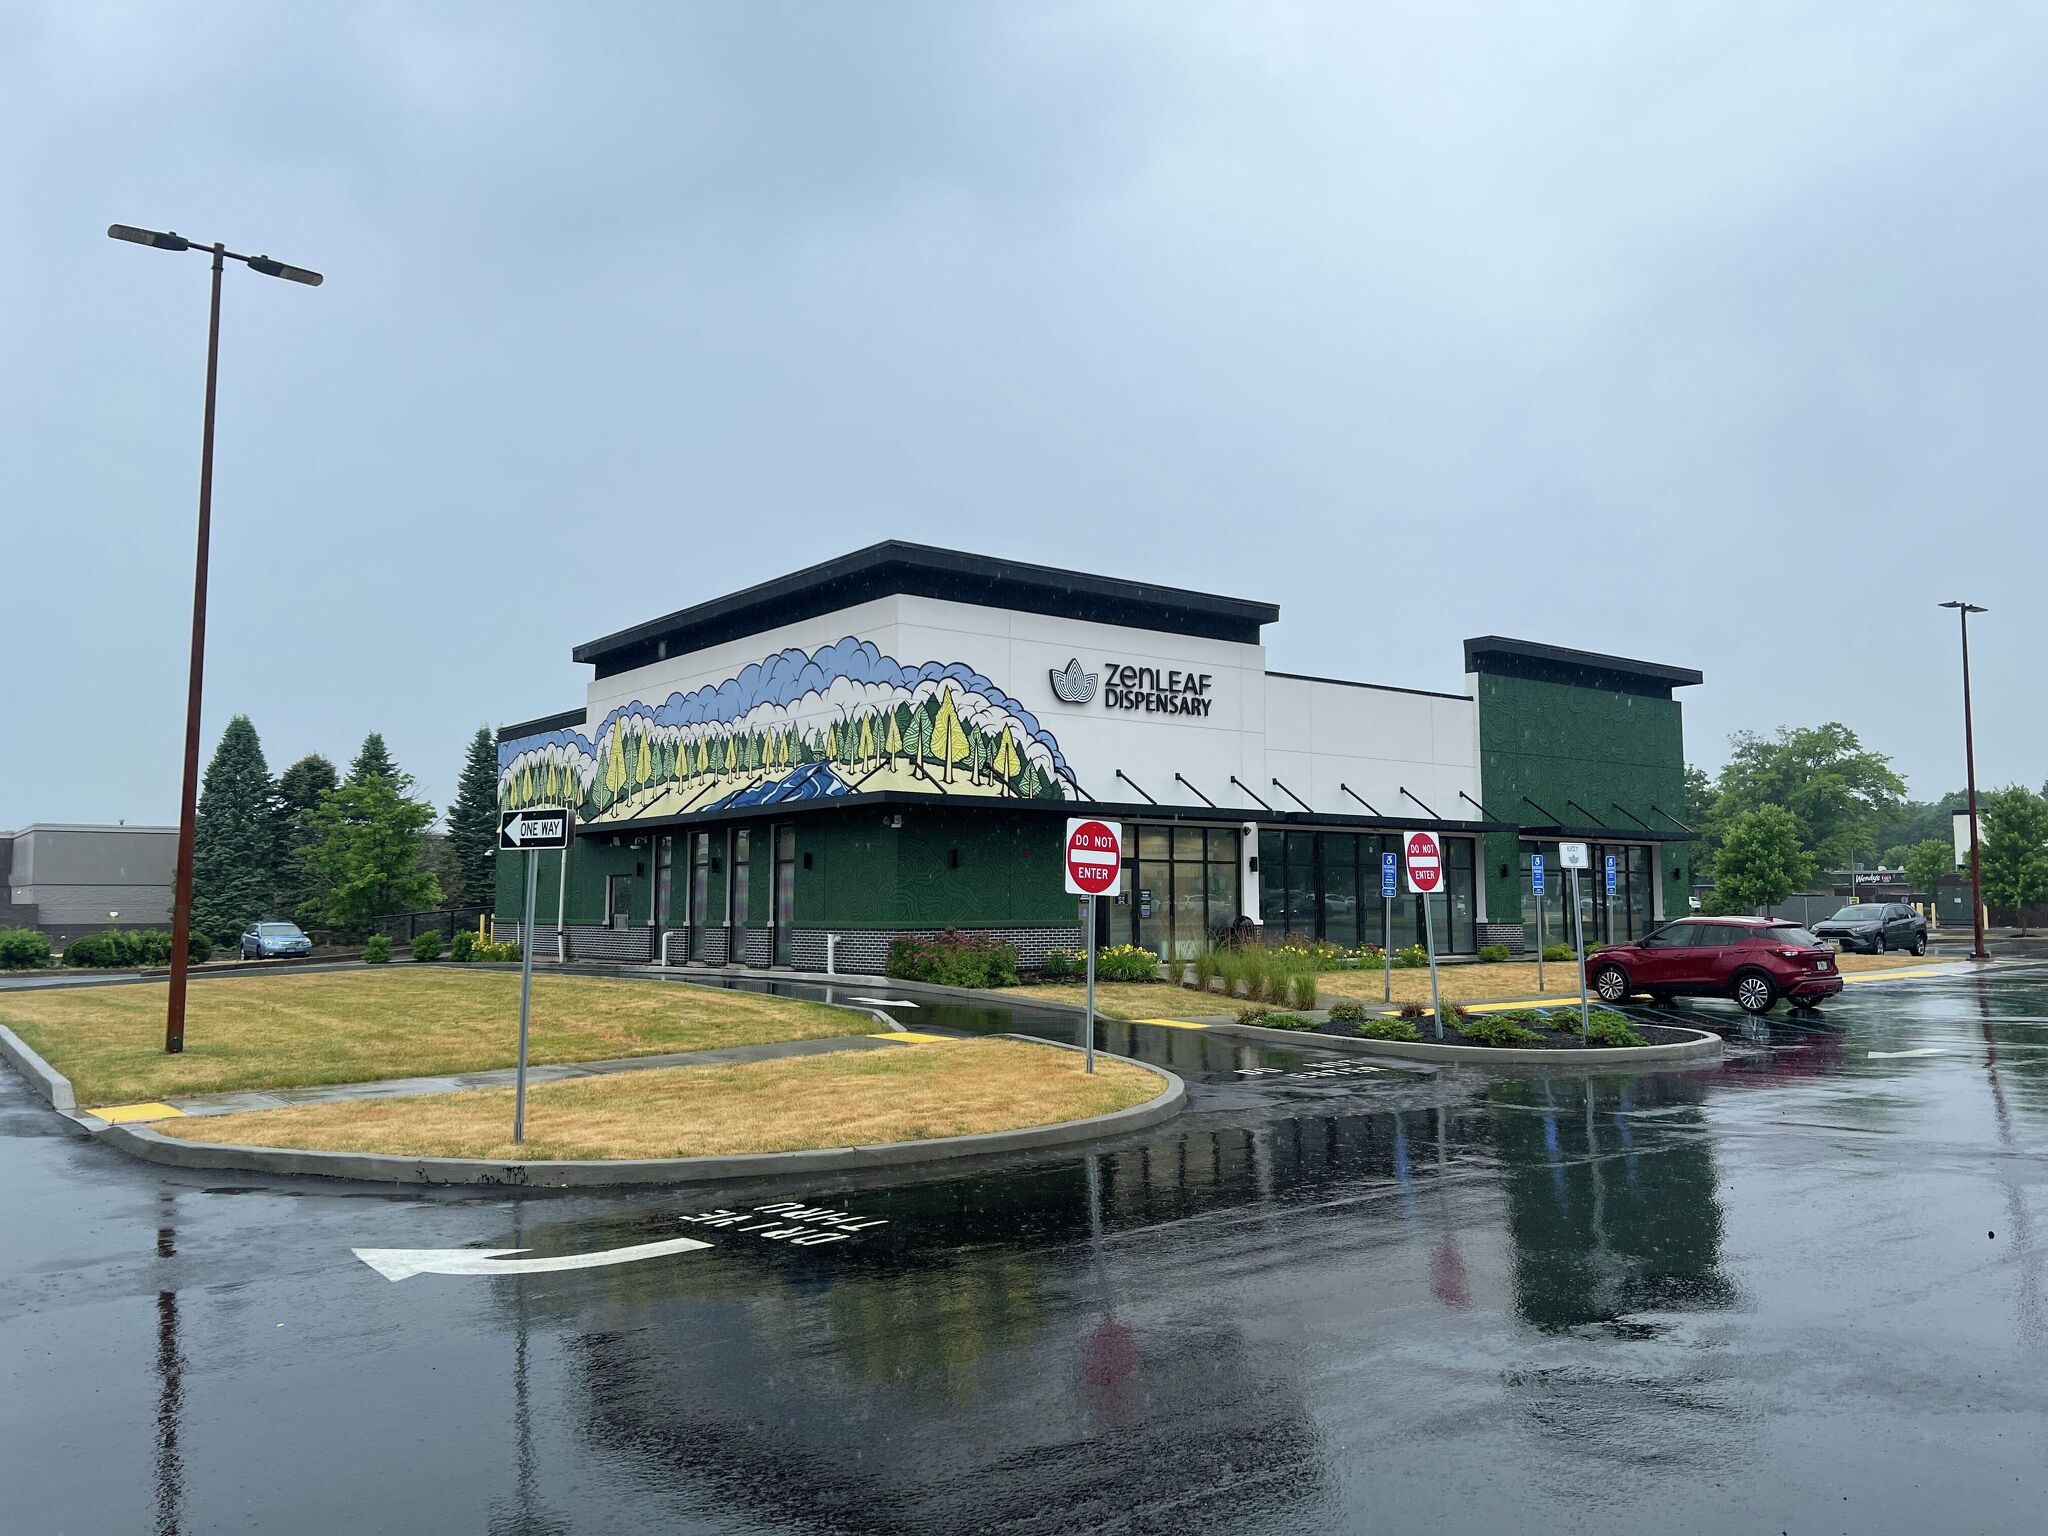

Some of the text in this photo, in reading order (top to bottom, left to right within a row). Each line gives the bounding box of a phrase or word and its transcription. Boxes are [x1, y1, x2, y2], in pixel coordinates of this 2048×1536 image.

[1105, 688, 1212, 717] DISPENSARY
[520, 821, 560, 836] ONE WAY
[1075, 834, 1113, 848] DO NOT
[1410, 844, 1435, 854] DO NOT
[1078, 867, 1109, 880] ENTER
[1415, 870, 1435, 880] ENTER
[753, 1202, 889, 1232] THRU
[678, 1209, 851, 1246] DRIVE
